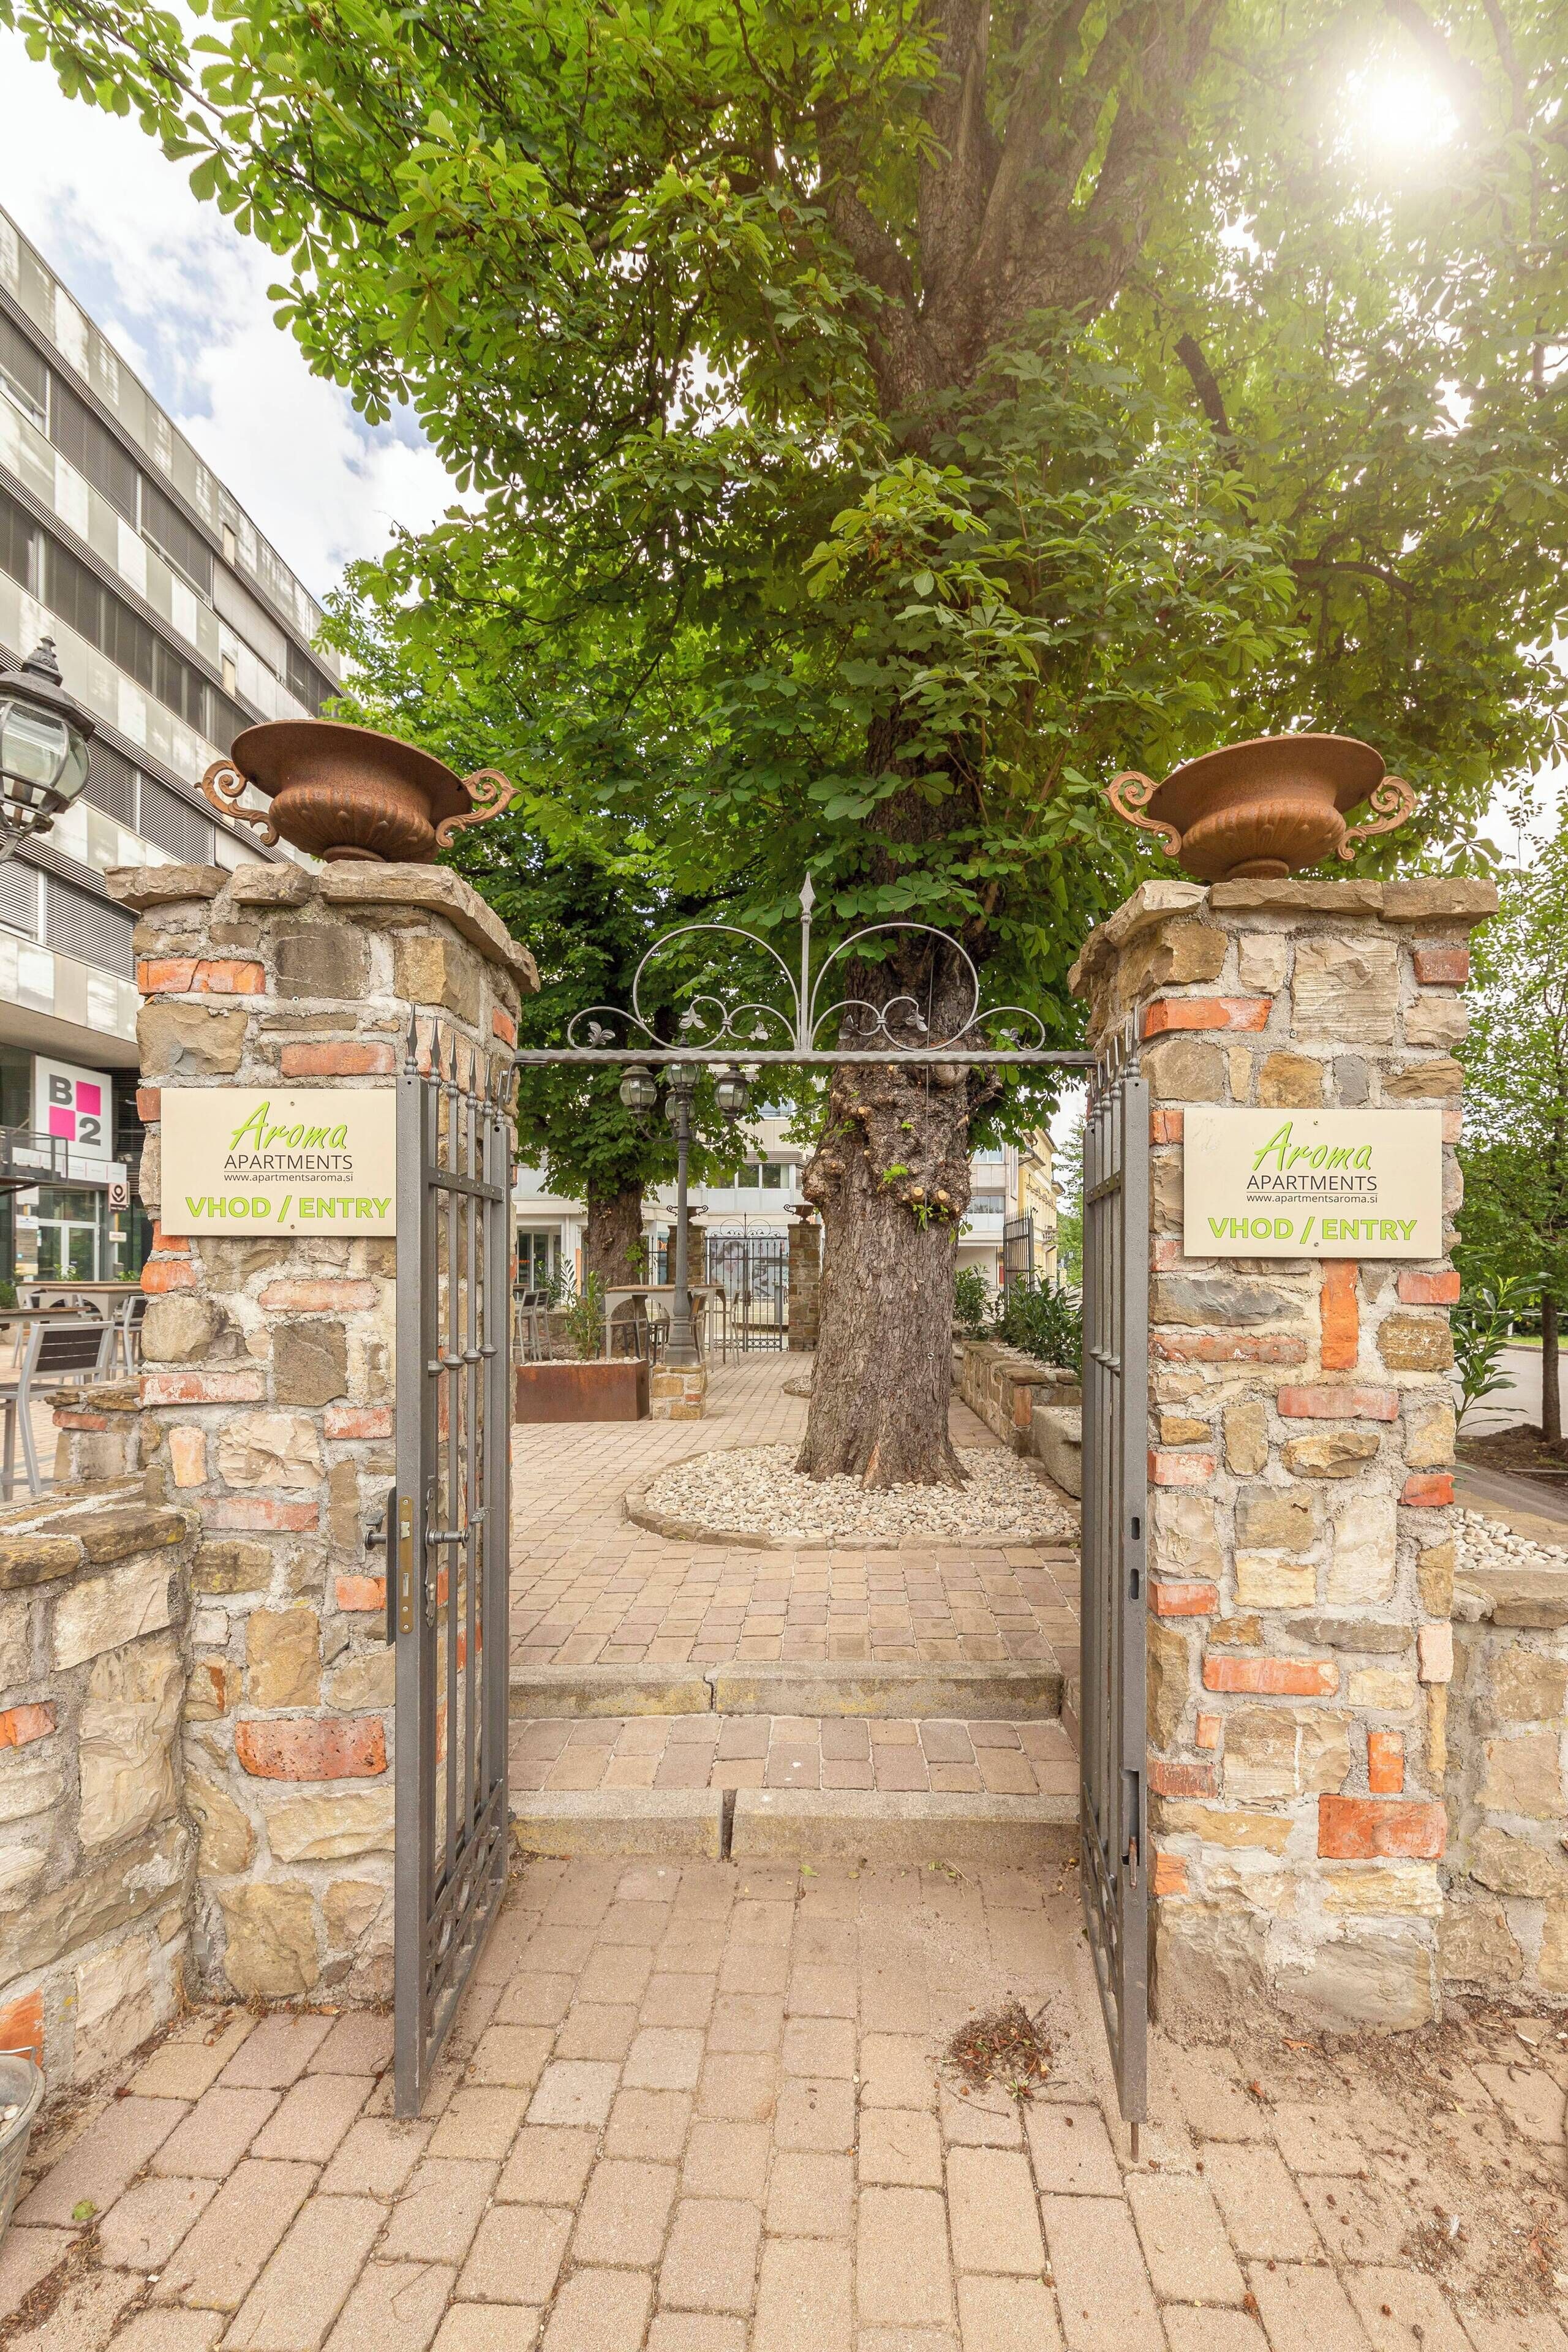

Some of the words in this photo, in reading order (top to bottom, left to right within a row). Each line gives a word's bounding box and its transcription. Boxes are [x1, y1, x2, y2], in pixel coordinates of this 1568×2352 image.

[49, 1074, 72, 1105] B
[79, 1117, 101, 1146] 2
[229, 1101, 348, 1150] Aroma
[1252, 1121, 1372, 1171] Aroma
[224, 1155, 353, 1169] APARTMENTS
[224, 1173, 353, 1182] www.apartmentsaroma.si
[1246, 1175, 1378, 1191] APARTMENTS
[185, 1196, 271, 1218] VHOD
[299, 1197, 392, 1218] ENTRY
[1246, 1194, 1378, 1204] www.apartmentsaroma.si
[1208, 1217, 1294, 1238] VHOD
[1322, 1219, 1417, 1240] ENTRY
